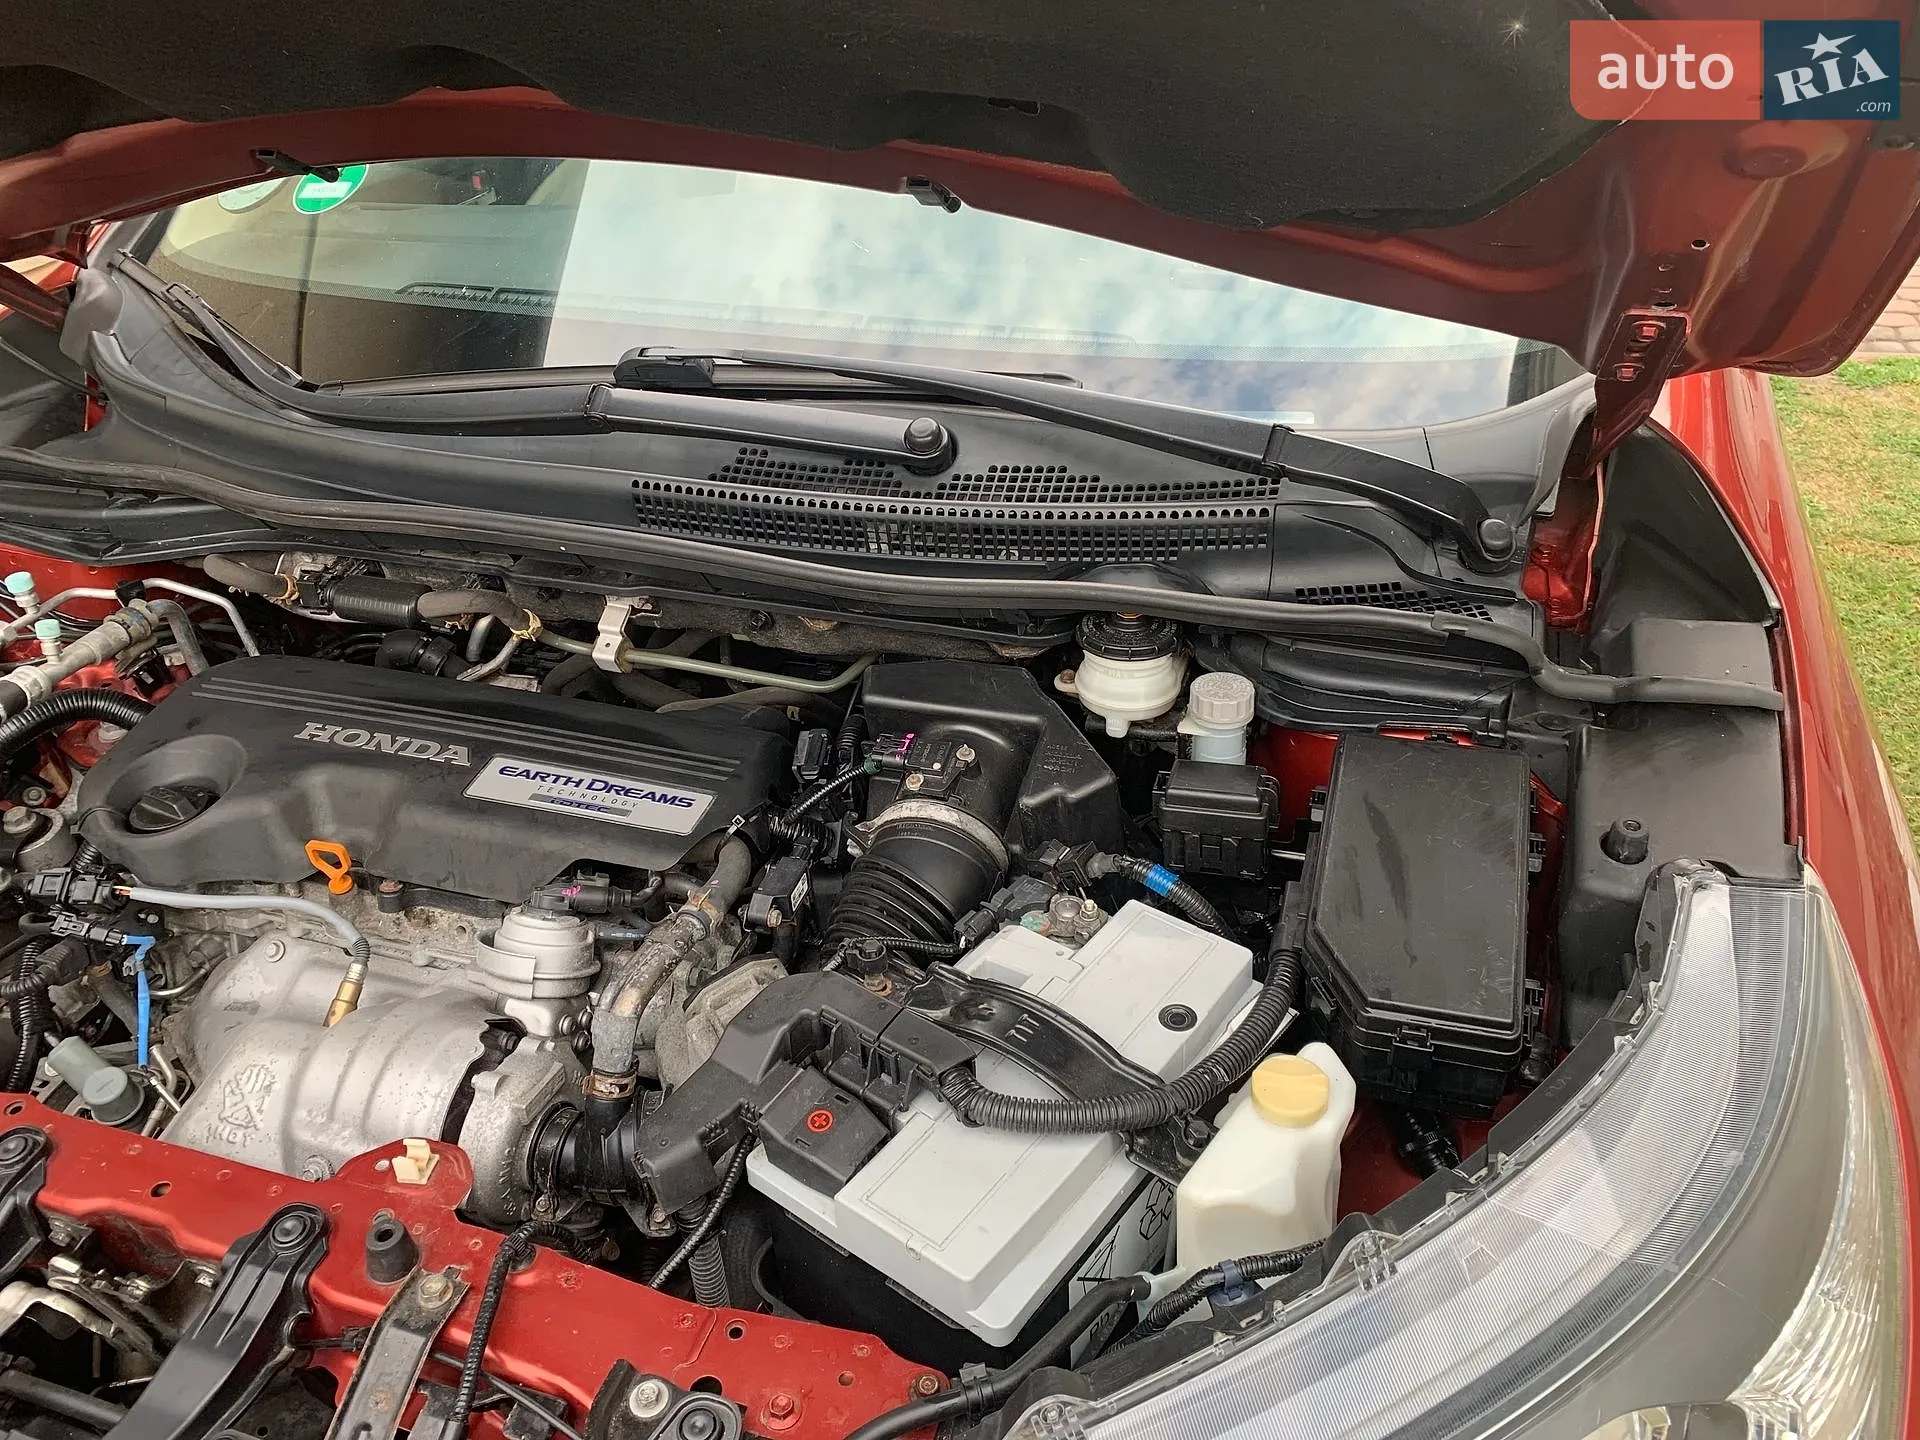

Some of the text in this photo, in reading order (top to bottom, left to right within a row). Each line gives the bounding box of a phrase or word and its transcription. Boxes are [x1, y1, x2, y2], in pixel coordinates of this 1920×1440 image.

[293, 721, 472, 766] HONDA
[498, 765, 584, 788] EARTH
[537, 785, 639, 808] TECHNOLOGY
